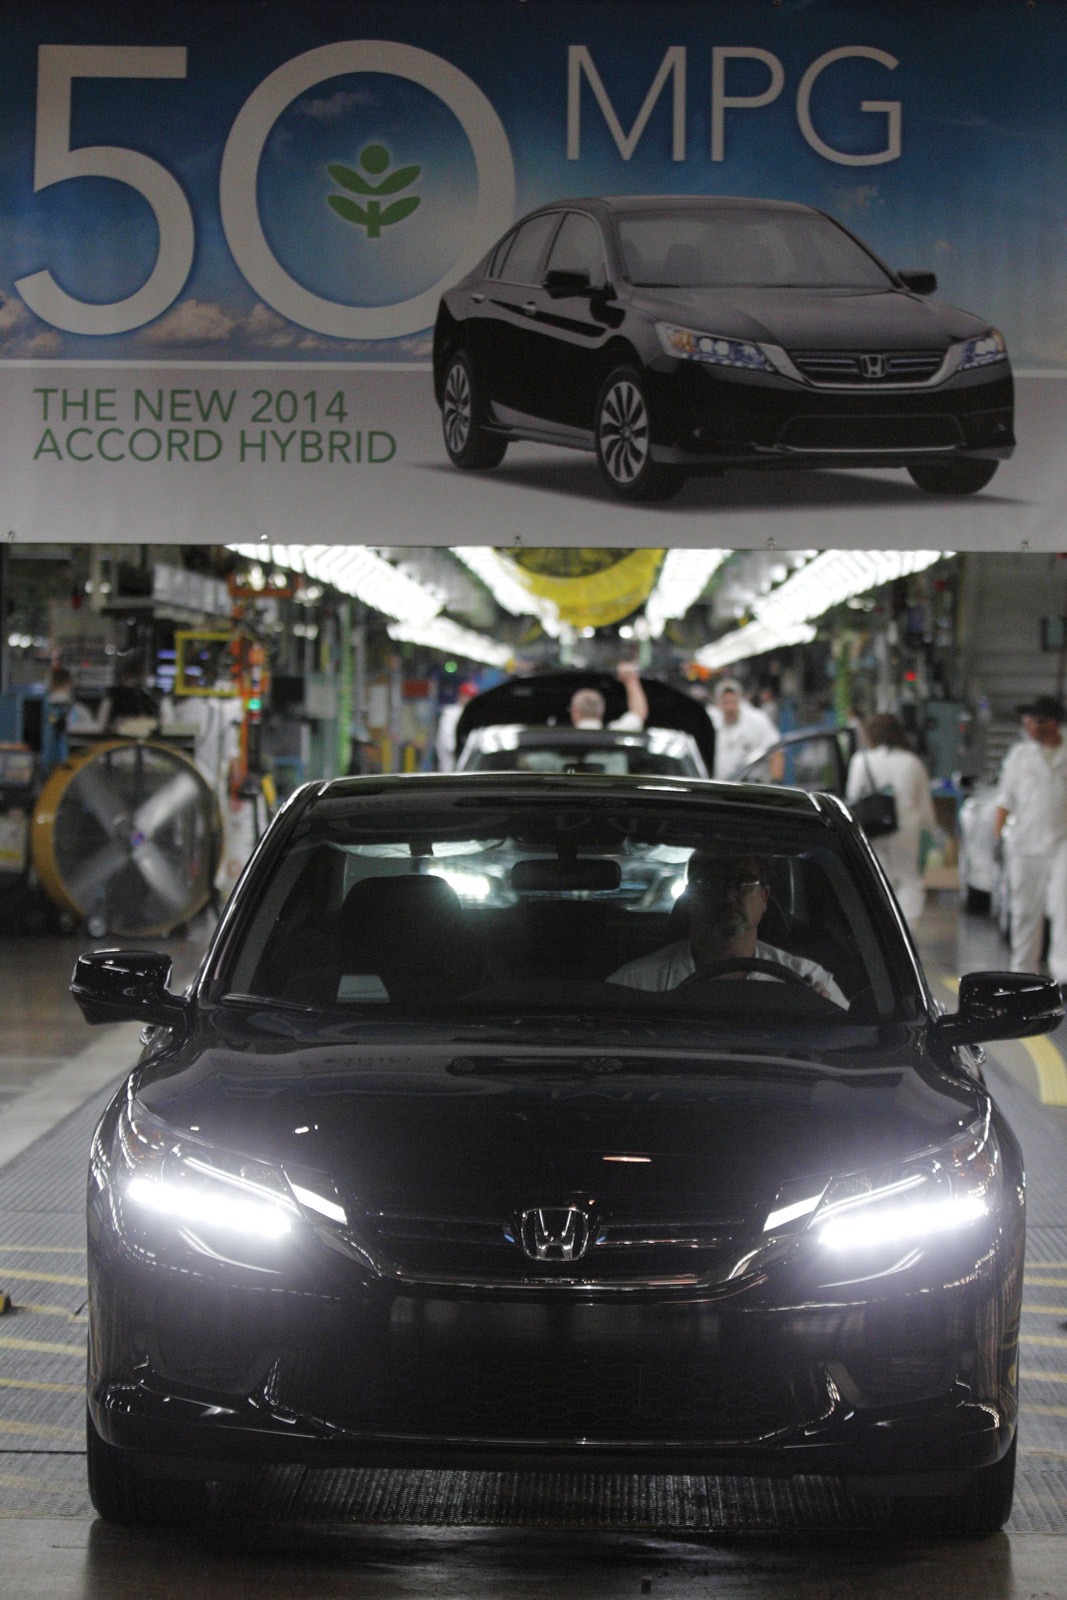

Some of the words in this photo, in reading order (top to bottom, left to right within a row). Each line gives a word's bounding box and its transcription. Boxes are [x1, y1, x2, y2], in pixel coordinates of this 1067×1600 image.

[14, 39, 516, 340] 50
[566, 44, 903, 167] MPG
[33, 388, 117, 421] THE
[134, 389, 237, 423] NEW
[251, 390, 348, 424] 2014
[32, 428, 223, 462] ACCORD
[240, 430, 397, 465] HYBRID
